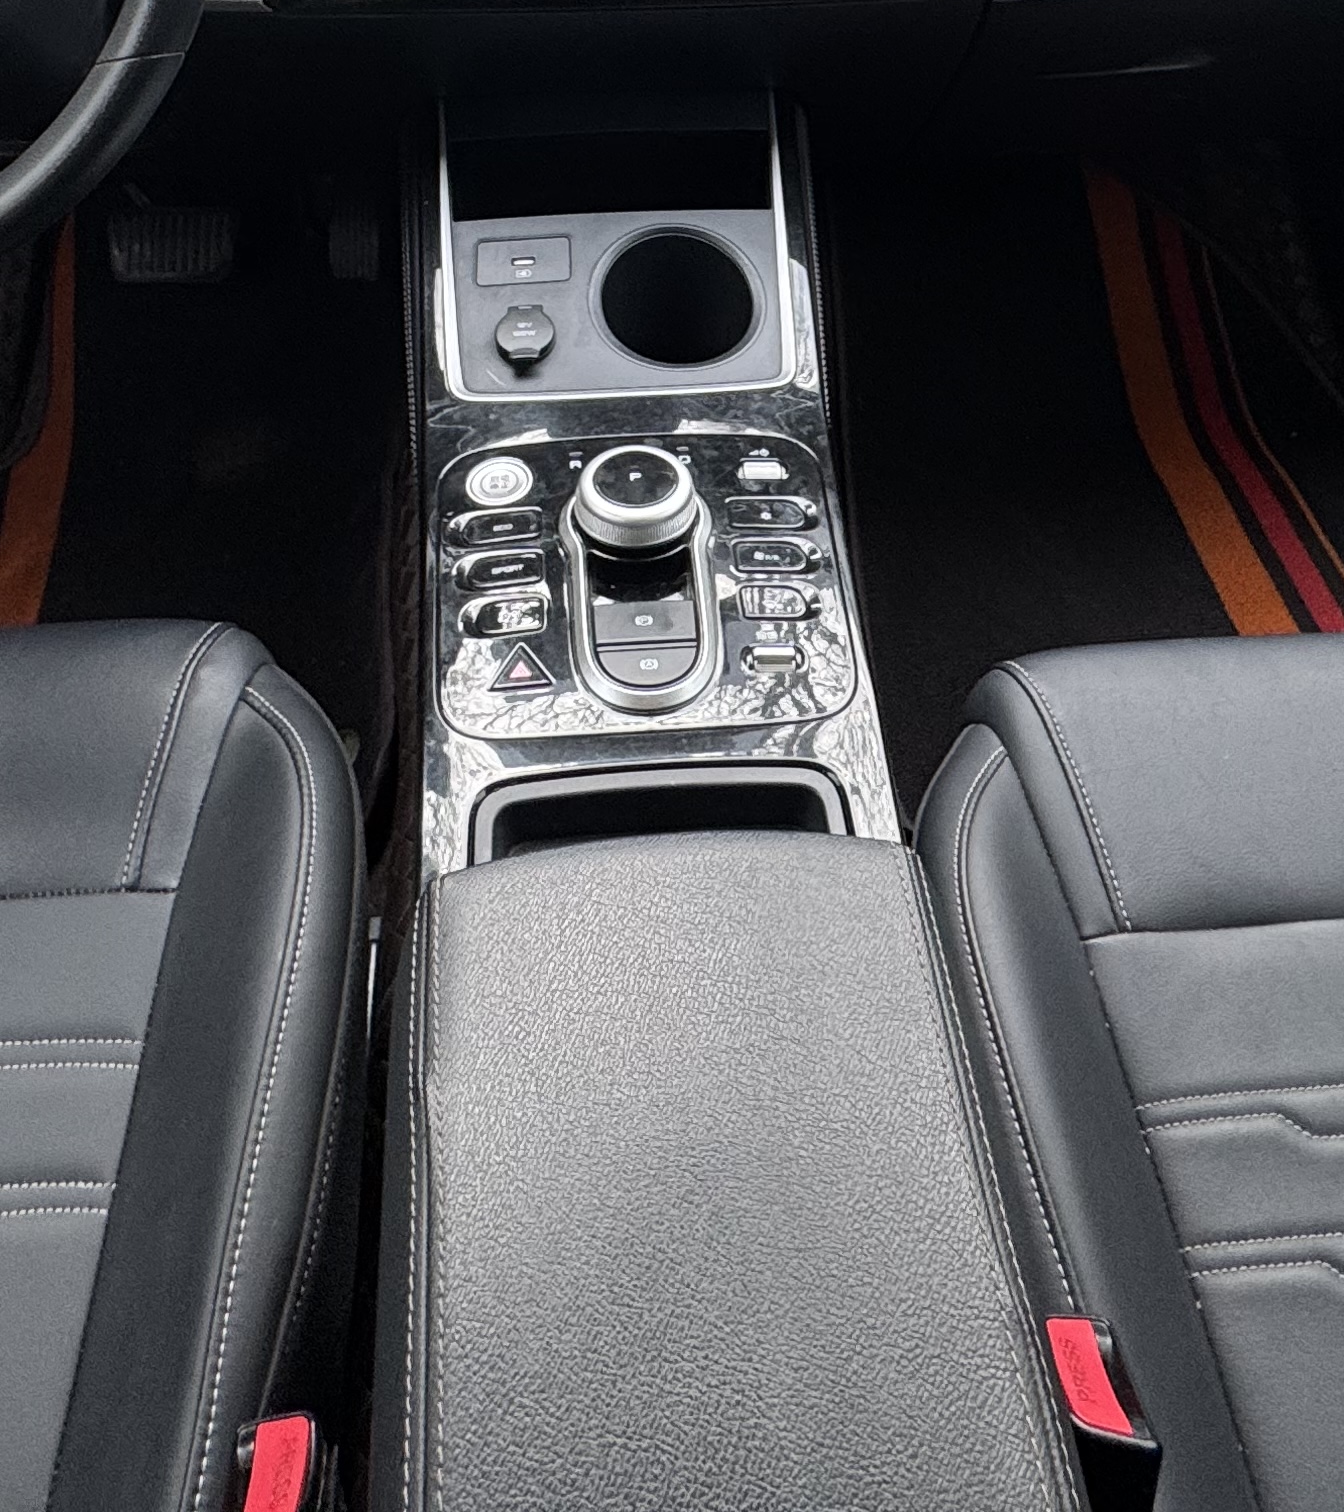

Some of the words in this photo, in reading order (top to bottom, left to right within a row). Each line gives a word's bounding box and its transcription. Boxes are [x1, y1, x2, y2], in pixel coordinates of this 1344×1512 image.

[628, 472, 643, 482] P
[490, 563, 525, 575] SPORT
[1057, 1336, 1097, 1405] PRESS
